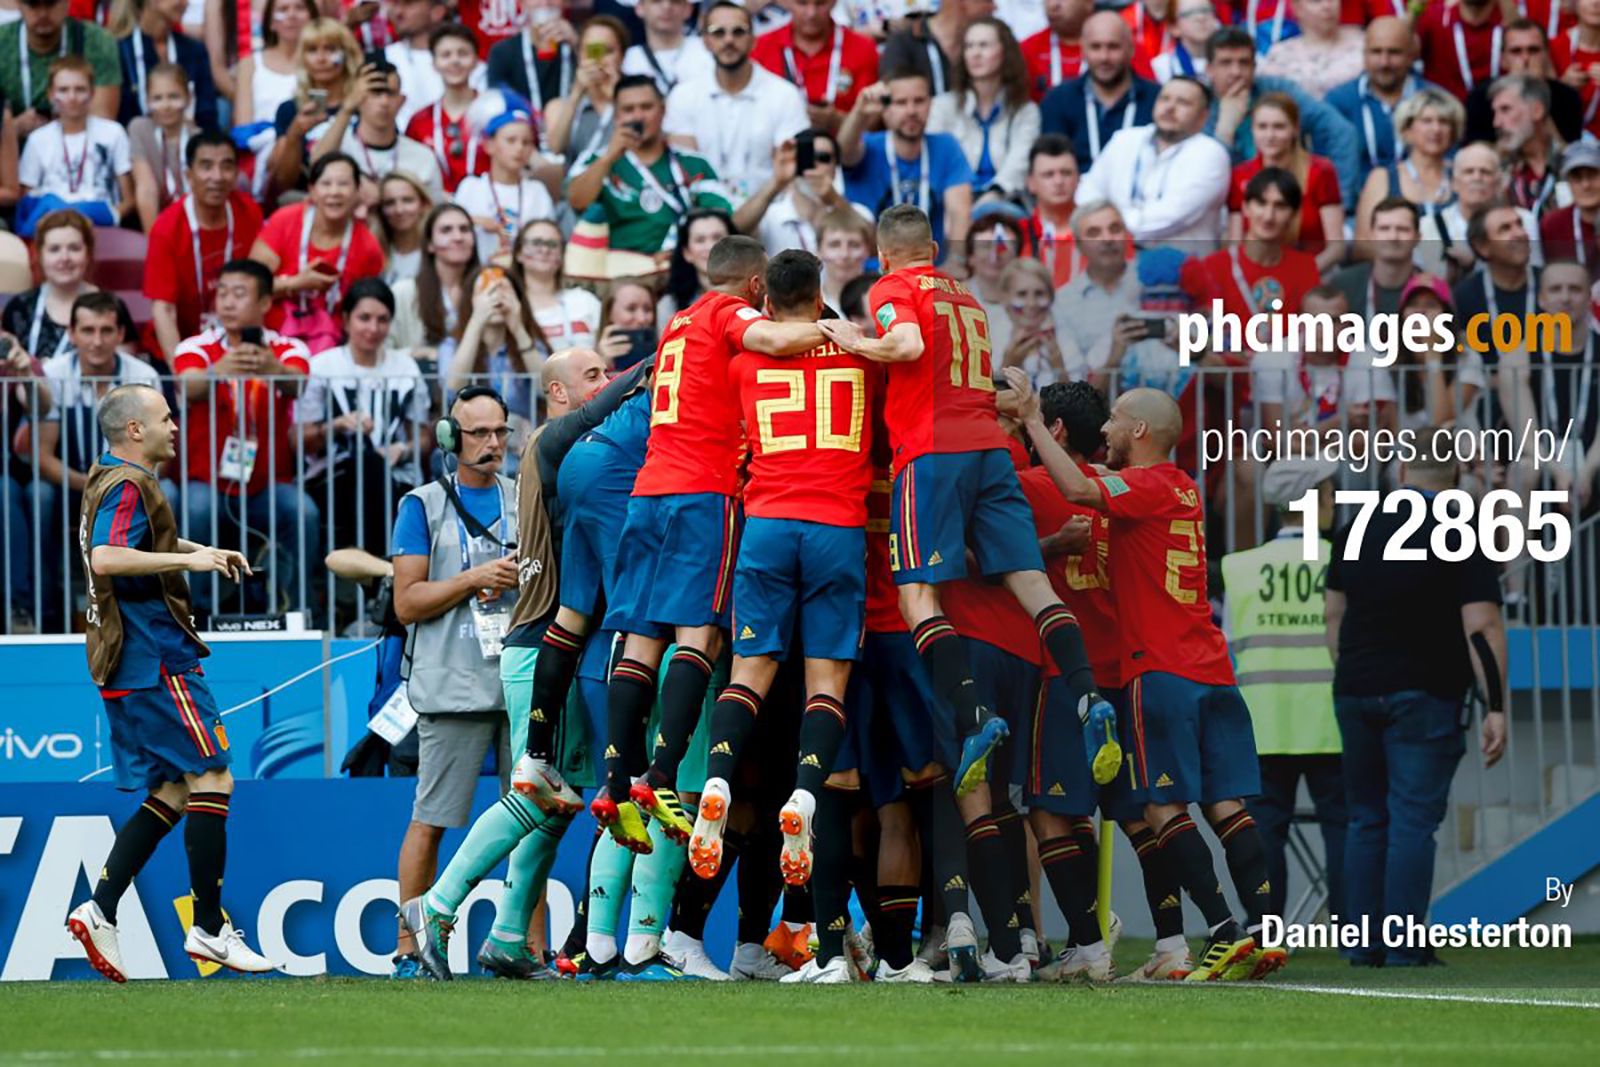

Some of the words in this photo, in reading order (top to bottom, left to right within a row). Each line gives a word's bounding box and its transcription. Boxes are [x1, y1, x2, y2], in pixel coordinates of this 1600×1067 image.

[933, 301, 997, 392] 18
[649, 336, 686, 428] 8
[755, 367, 865, 454] 20
[1258, 562, 1329, 602] 3104
[244, 620, 281, 630] NEX
[0, 727, 82, 760] ivo
